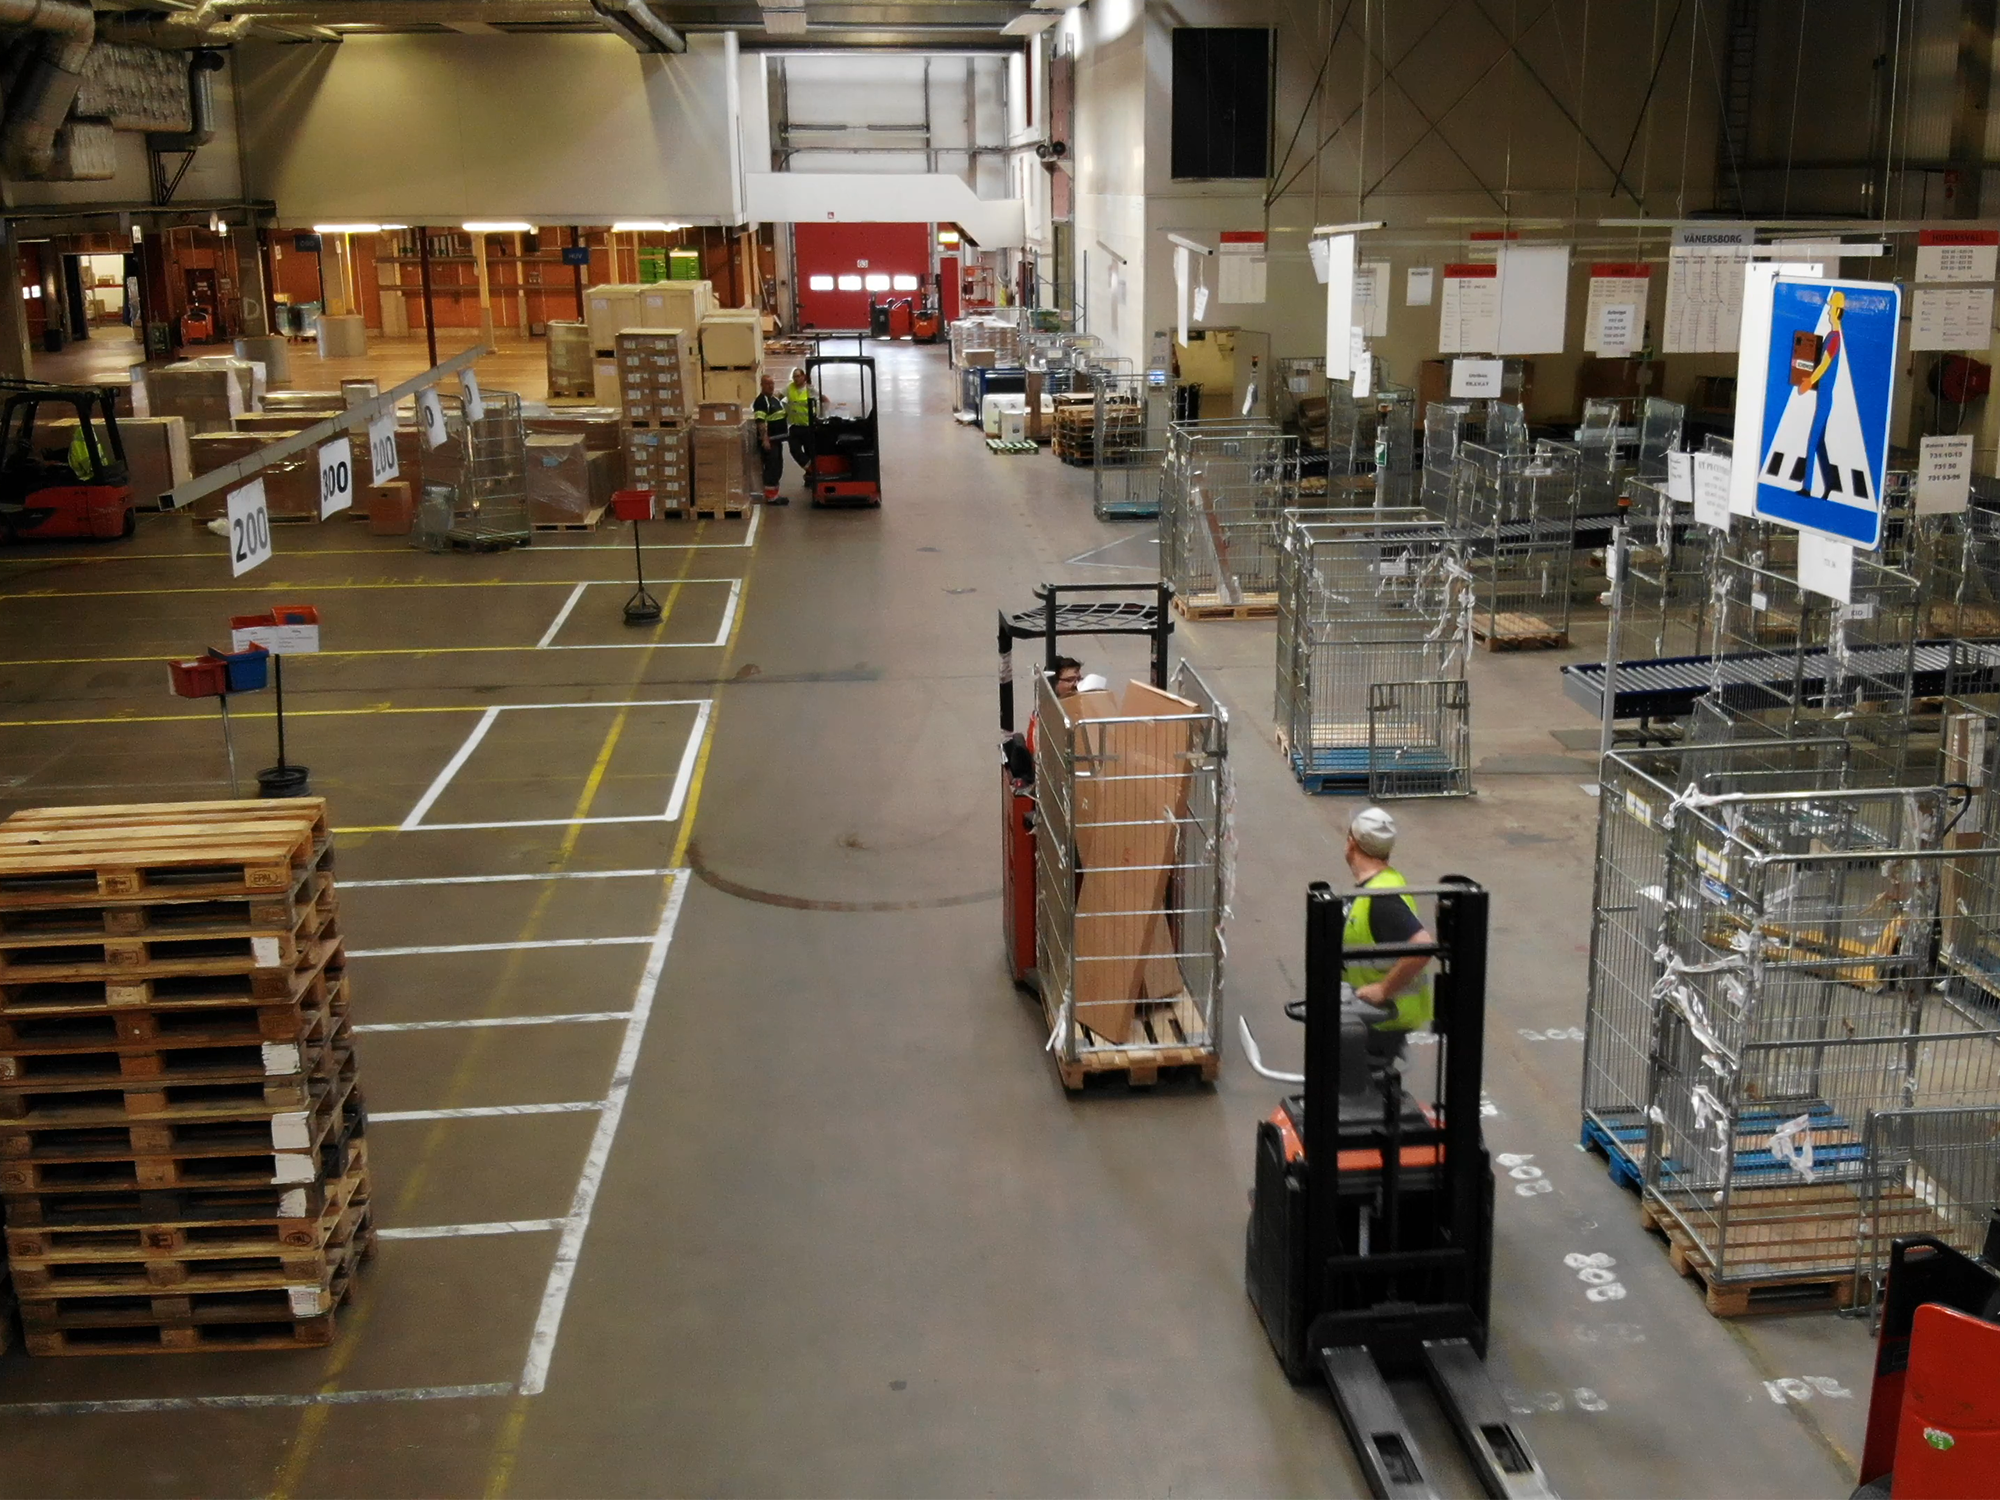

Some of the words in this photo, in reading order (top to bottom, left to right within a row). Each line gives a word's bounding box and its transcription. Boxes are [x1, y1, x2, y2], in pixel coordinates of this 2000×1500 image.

[1932, 233, 1985, 242] HUDIKSVALL
[372, 435, 395, 474] 200
[322, 460, 348, 503] 300
[233, 506, 268, 563] 200
